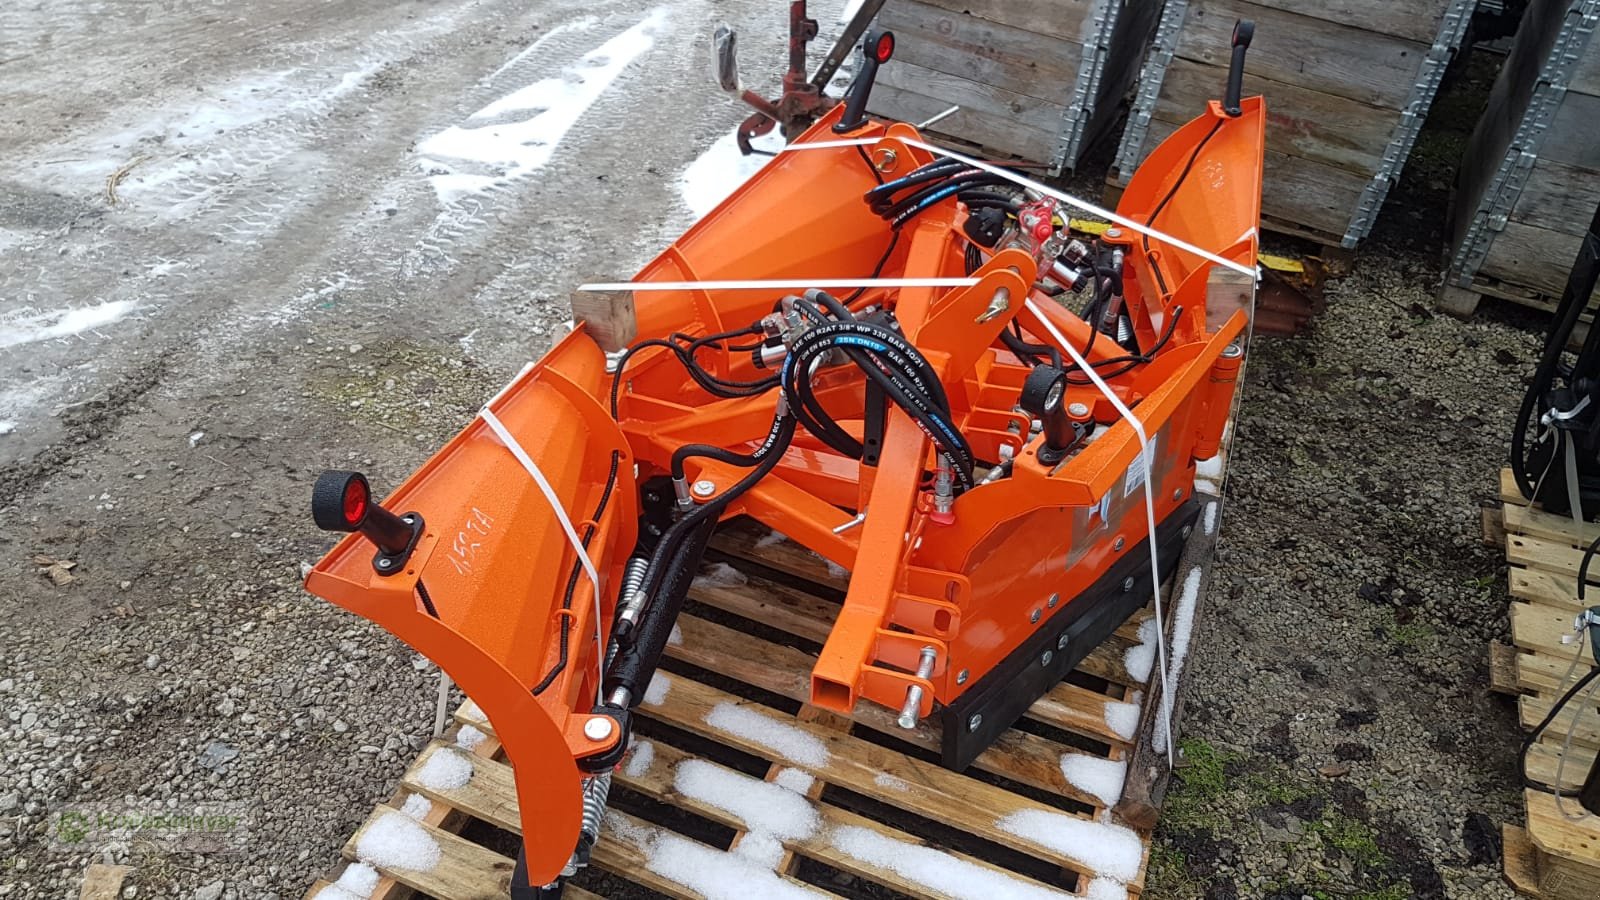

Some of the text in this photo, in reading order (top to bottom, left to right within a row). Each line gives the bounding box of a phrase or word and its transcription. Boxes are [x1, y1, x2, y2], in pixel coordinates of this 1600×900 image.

[792, 340, 804, 353] SAE
[804, 332, 816, 342] 100
[816, 324, 837, 336] R2AT
[856, 324, 871, 333] WP
[872, 329, 887, 339] 330
[887, 336, 905, 351] BAR
[887, 351, 905, 365] SAE
[903, 365, 915, 378] 100
[891, 376, 904, 389] DIN
[764, 433, 776, 448] BAR
